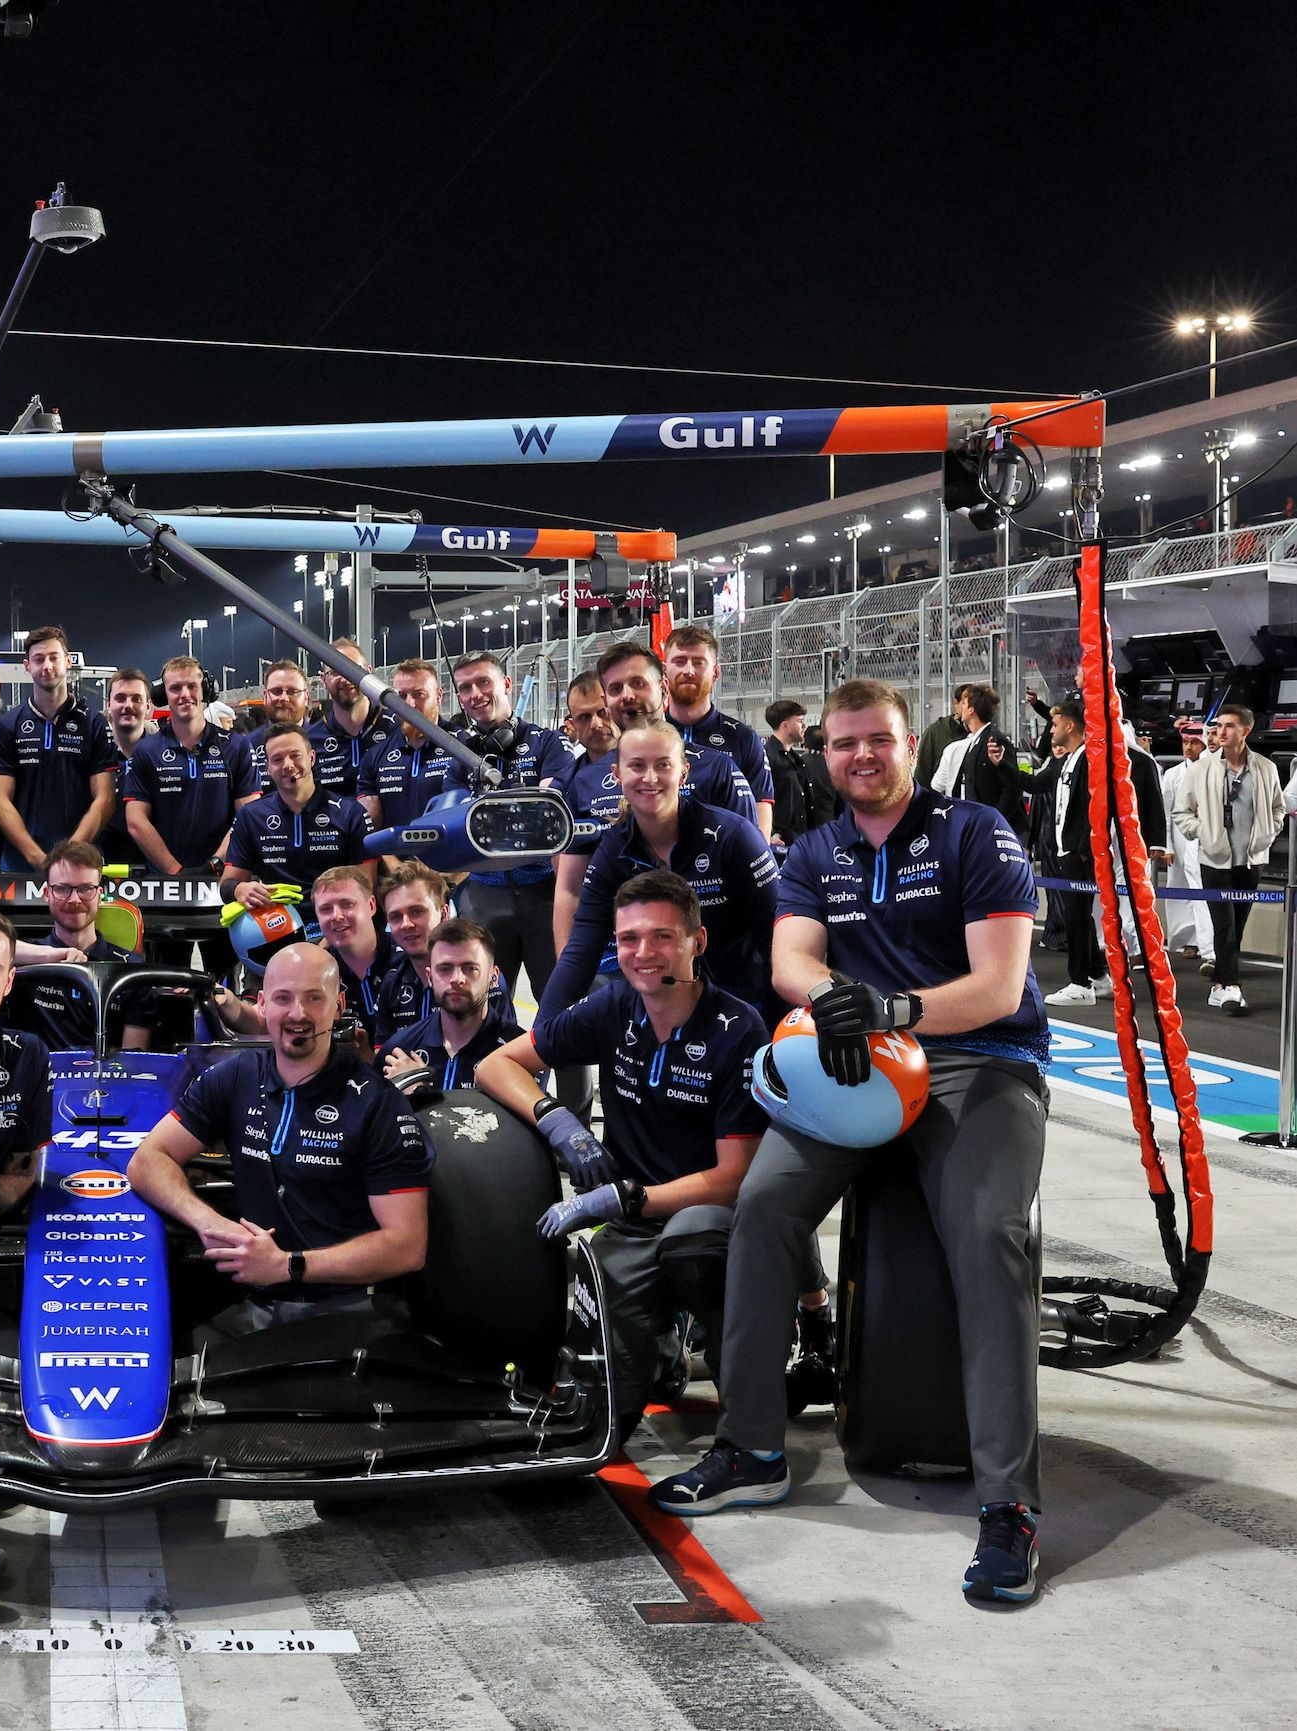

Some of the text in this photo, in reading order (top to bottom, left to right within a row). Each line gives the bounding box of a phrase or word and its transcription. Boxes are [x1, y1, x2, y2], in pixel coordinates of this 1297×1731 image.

[659, 416, 783, 448] Gulf
[441, 527, 511, 550] Gulf
[561, 589, 599, 599] QATA
[897, 861, 939, 876] WILLIAMS
[899, 870, 934, 885] RACING
[26, 881, 220, 900] MOTEIN
[697, 885, 721, 894] ACING
[1070, 882, 1099, 892] WILLIAM
[896, 886, 941, 902] DURACELL
[1221, 891, 1259, 901] WILLIAMS
[267, 917, 285, 928] Gulf
[670, 1065, 713, 1080] WILLIAMS
[673, 1075, 705, 1088] RACING
[667, 1089, 709, 1103] DURACELL
[245, 1125, 269, 1141] Steph
[299, 1129, 343, 1141] WILLIAMS
[52, 1131, 151, 1148] 43
[302, 1139, 338, 1149] RACING
[296, 1154, 342, 1165] DURACELL
[68, 1179, 131, 1188] Gulf
[46, 1212, 145, 1222] KOMATSU
[45, 1231, 130, 1241] Globant
[44, 1254, 146, 1264] INGENUITY
[79, 1278, 147, 1286] VAST
[65, 1303, 148, 1311] KEEPER
[41, 1325, 149, 1338] JUMEIRAH
[40, 1352, 150, 1368] PIRELLI
[37, 1640, 69, 1650] 10
[104, 1639, 123, 1649] 0
[217, 1640, 315, 1651] 20 30
